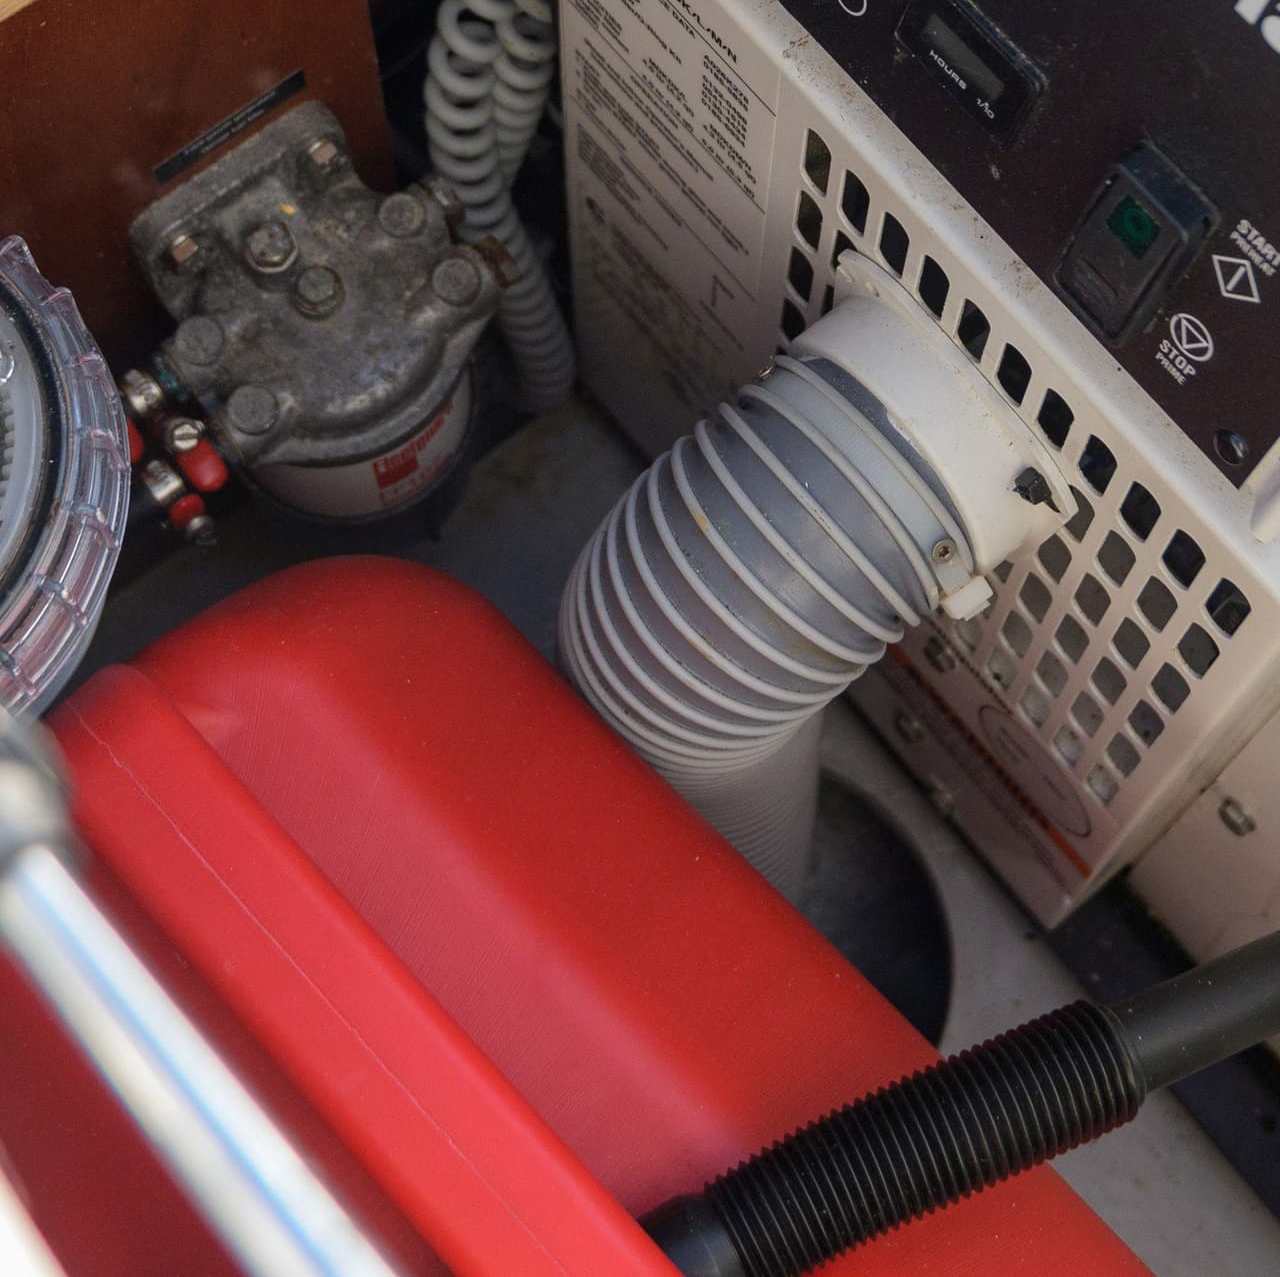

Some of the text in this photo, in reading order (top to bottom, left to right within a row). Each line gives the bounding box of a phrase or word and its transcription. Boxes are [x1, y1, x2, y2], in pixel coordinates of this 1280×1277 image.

[670, 8, 696, 40] DATA
[928, 48, 967, 90] HOURS
[1153, 350, 1187, 386] PRIME
[1157, 337, 1197, 381] STOP
